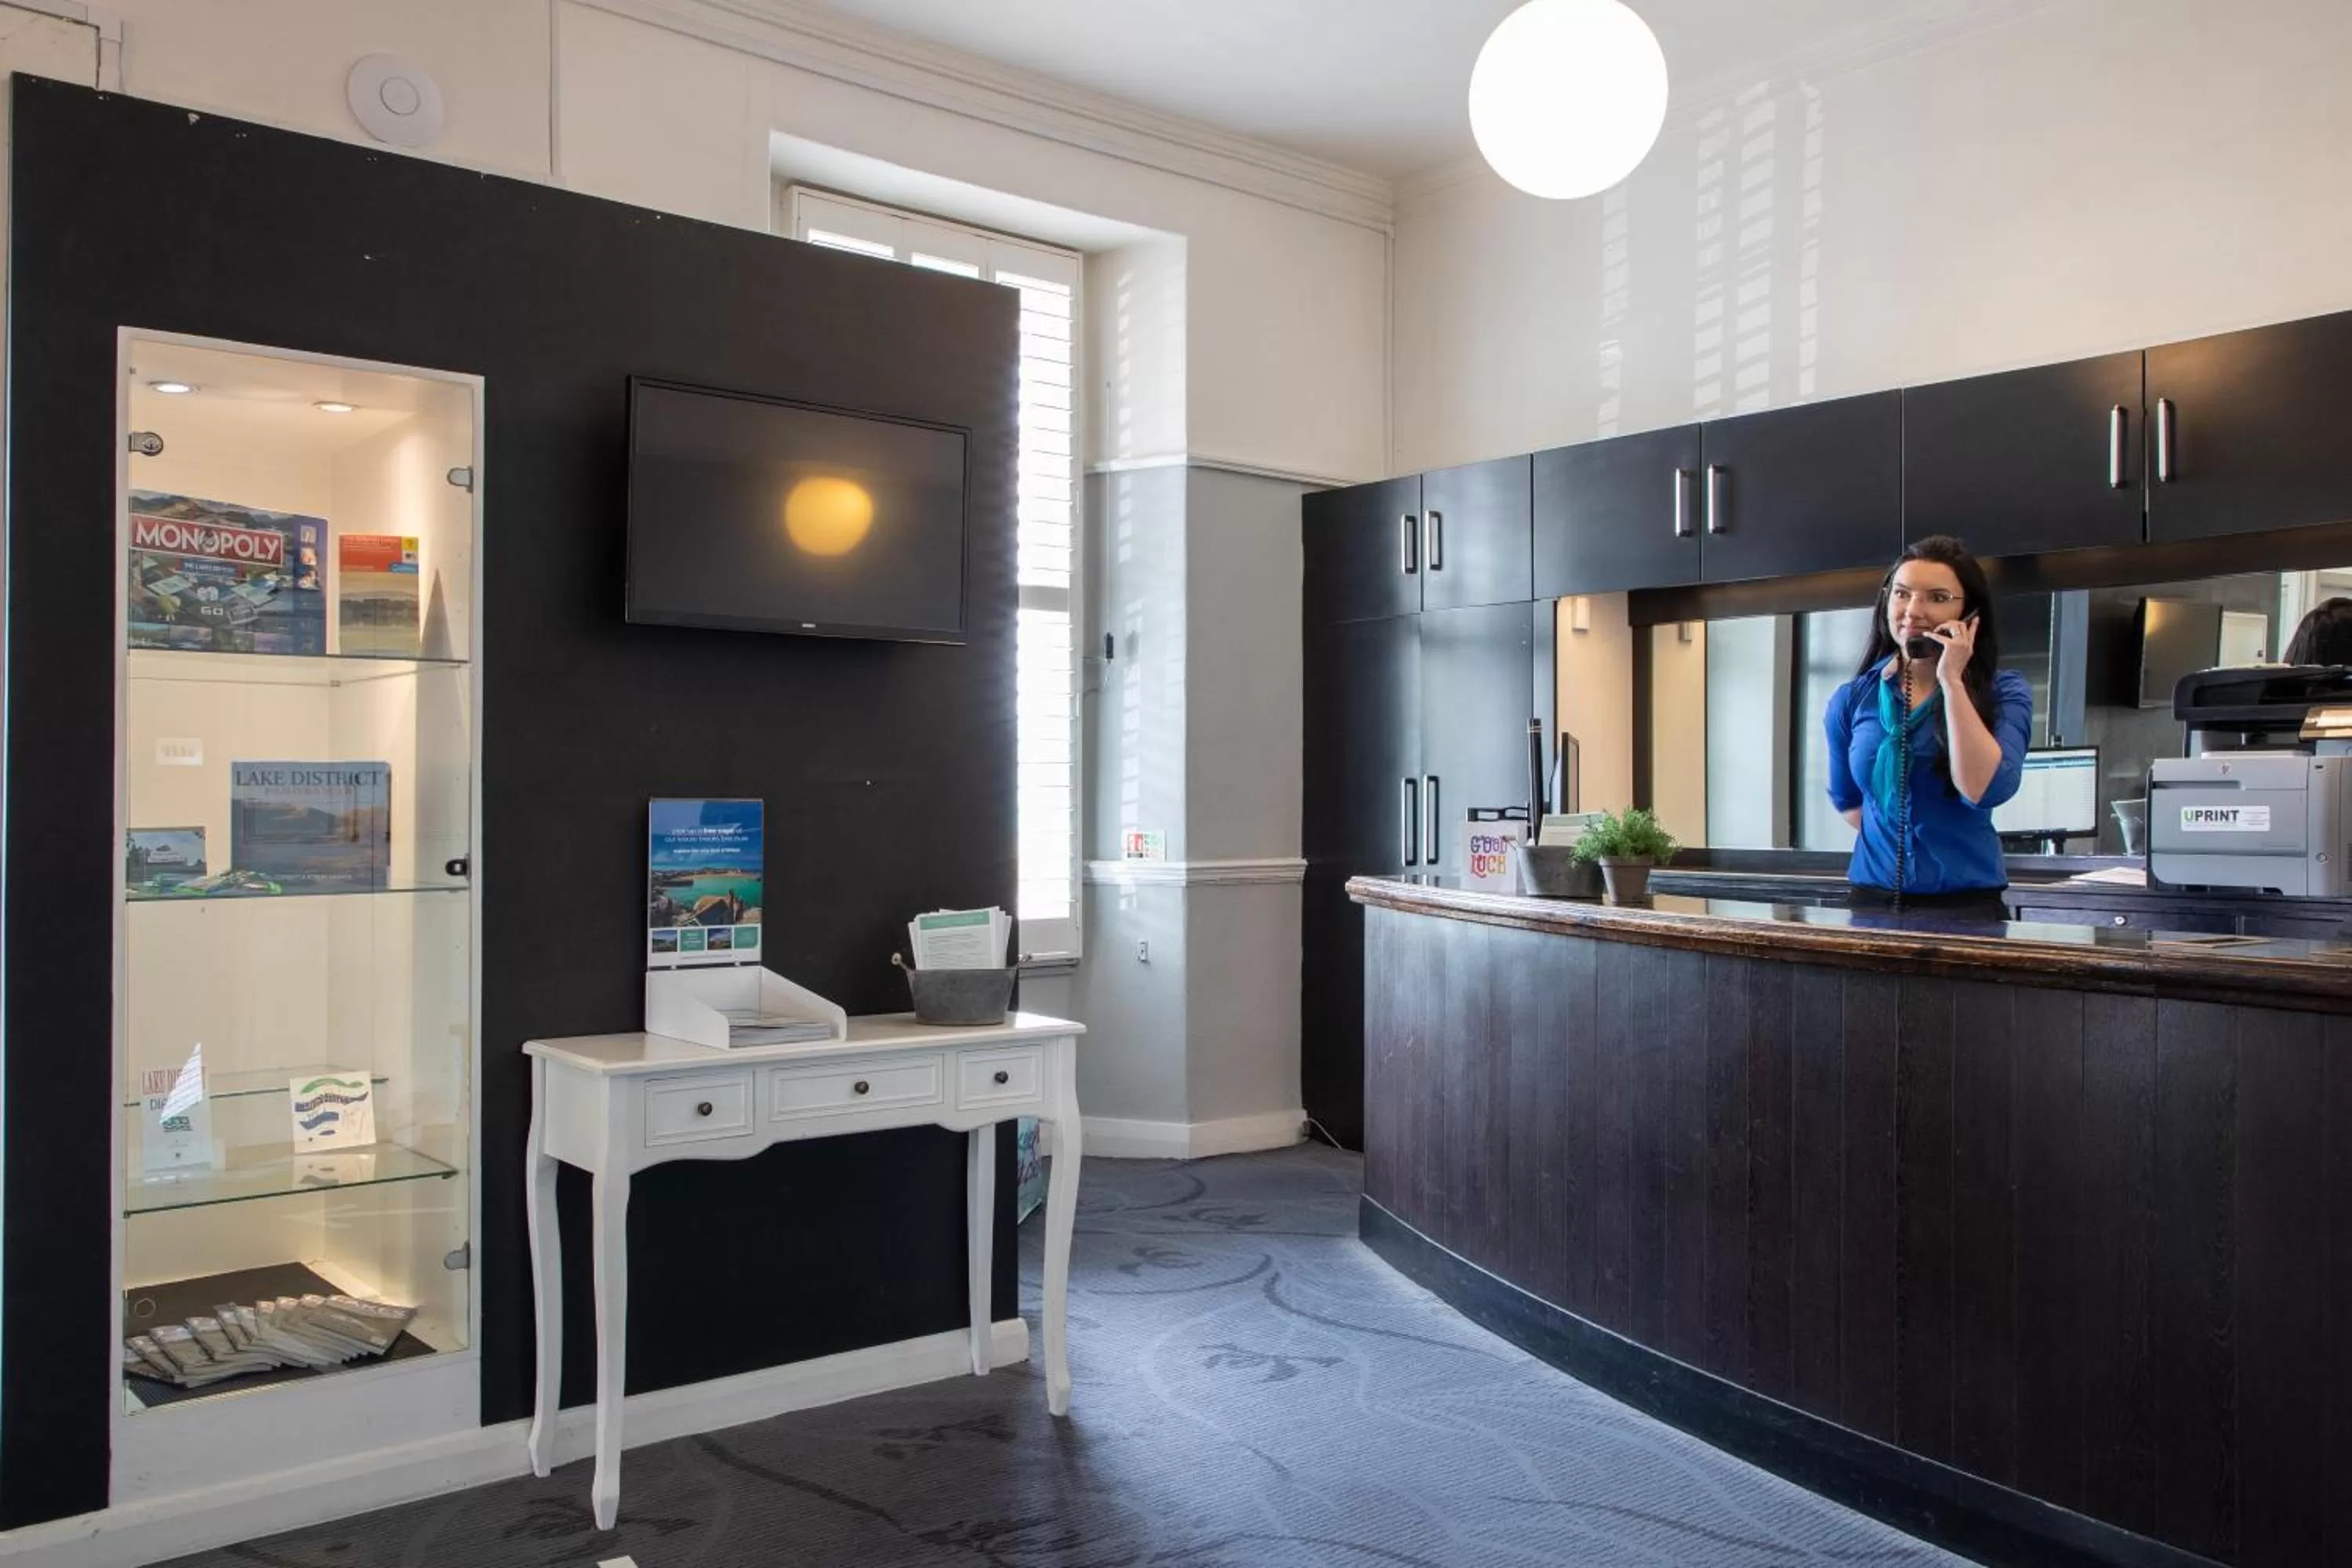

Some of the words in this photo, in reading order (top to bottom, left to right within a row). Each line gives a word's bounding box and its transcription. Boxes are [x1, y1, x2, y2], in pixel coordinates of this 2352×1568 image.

[136, 521, 279, 561] MONOPOLY
[236, 771, 284, 786] LAKE
[292, 771, 383, 786] DISTRICT
[2183, 809, 2240, 822] UPRINT
[1470, 835, 1508, 854] GOOD
